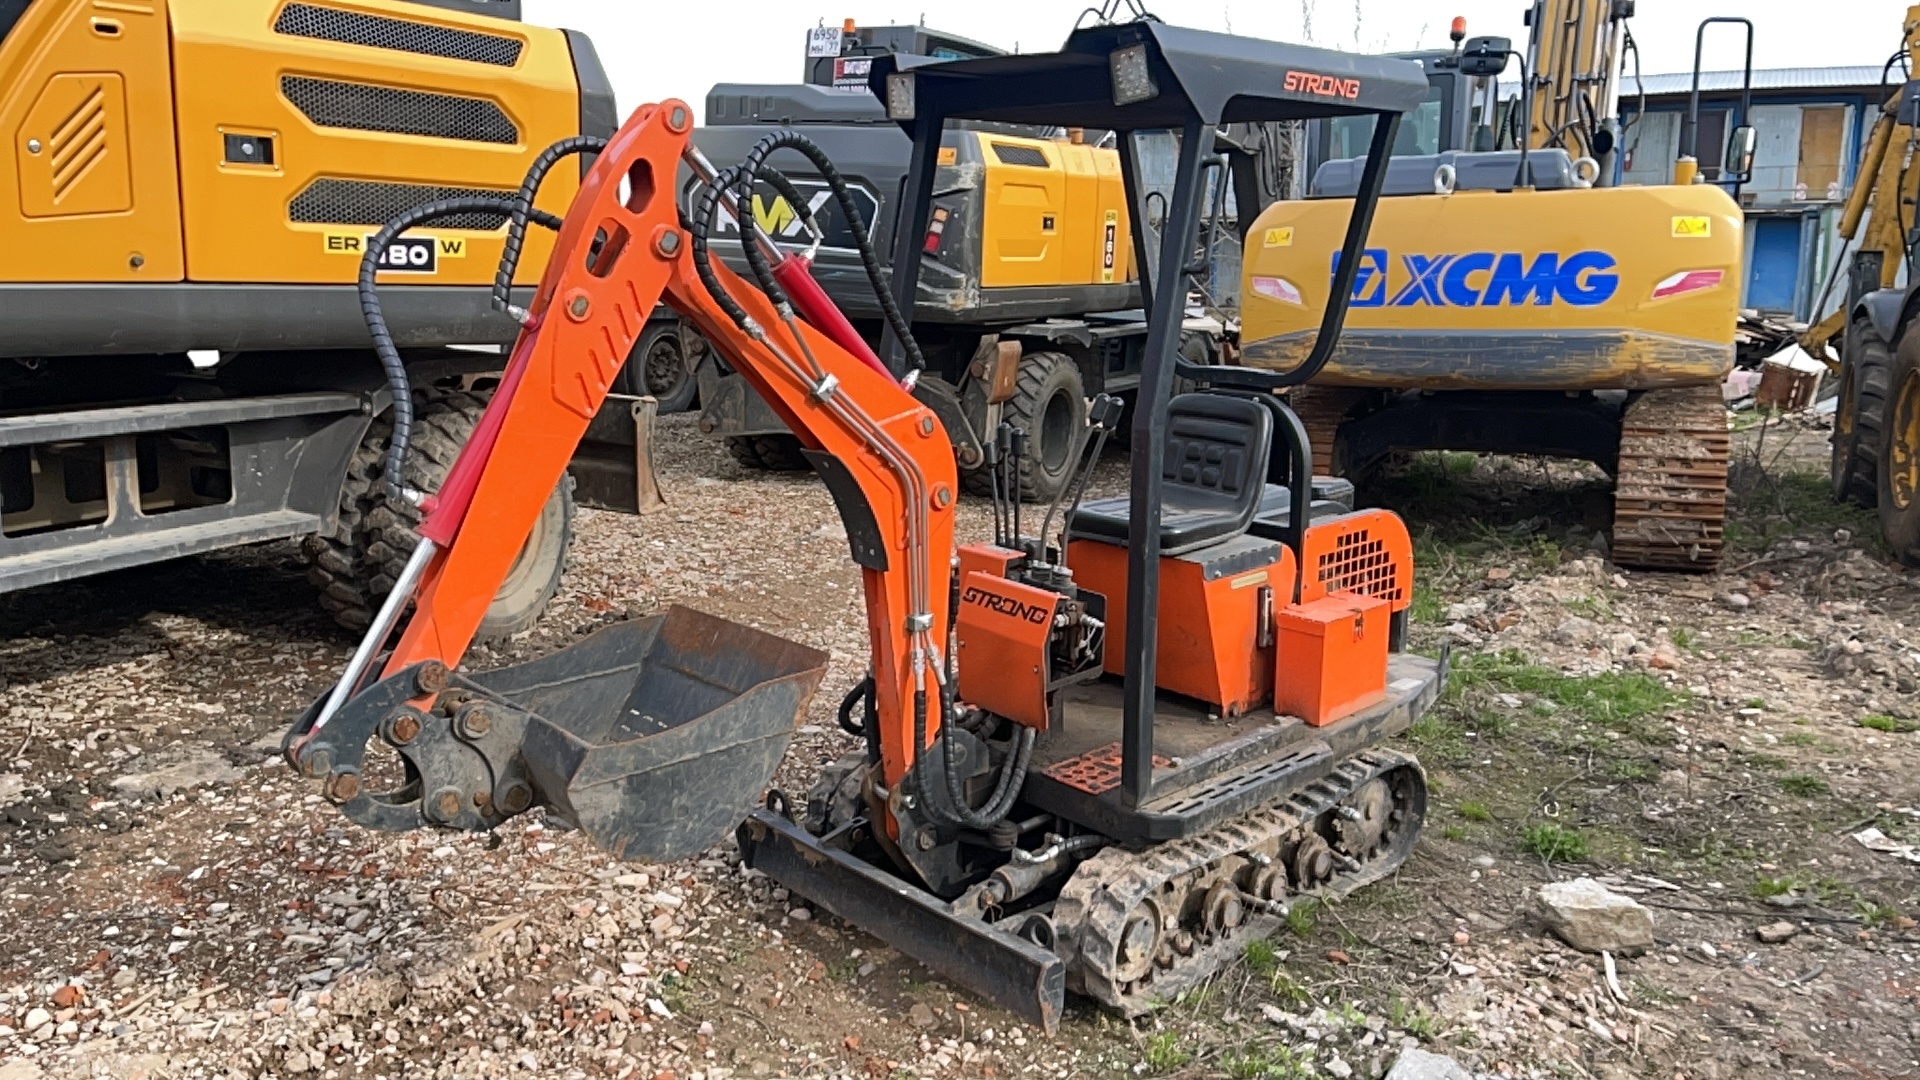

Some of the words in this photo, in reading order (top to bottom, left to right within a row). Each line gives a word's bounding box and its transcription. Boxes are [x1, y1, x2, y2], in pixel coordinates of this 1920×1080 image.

[814, 28, 839, 40] 6950
[1283, 70, 1360, 99] STRONG
[327, 235, 360, 250] ER
[441, 239, 462, 254] W
[1387, 250, 1620, 308] XCMG
[962, 586, 1049, 625] STRONG
